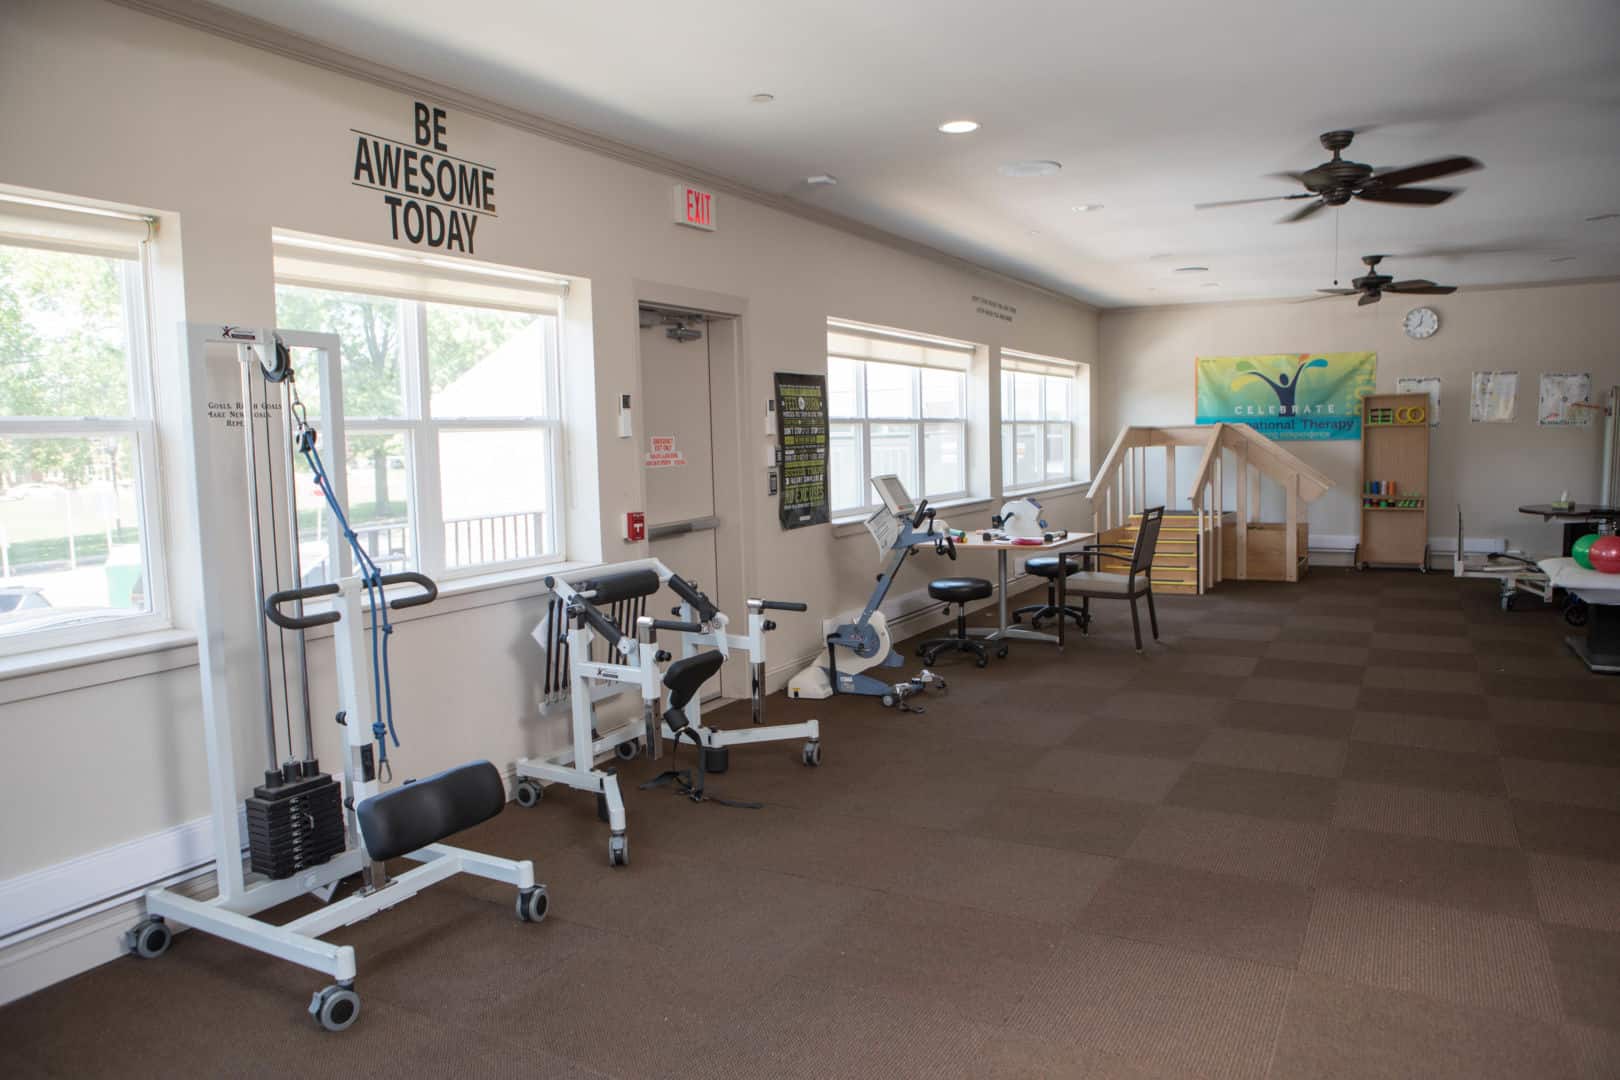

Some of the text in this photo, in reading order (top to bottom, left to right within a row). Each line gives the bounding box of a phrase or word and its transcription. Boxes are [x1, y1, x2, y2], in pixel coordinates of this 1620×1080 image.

[414, 101, 448, 152] BE
[354, 136, 496, 212] AWESOME
[384, 195, 478, 255] TODAY
[687, 188, 712, 225] EXIT
[1234, 403, 1336, 416] CELEBRATE
[1302, 418, 1354, 432] Therapy
